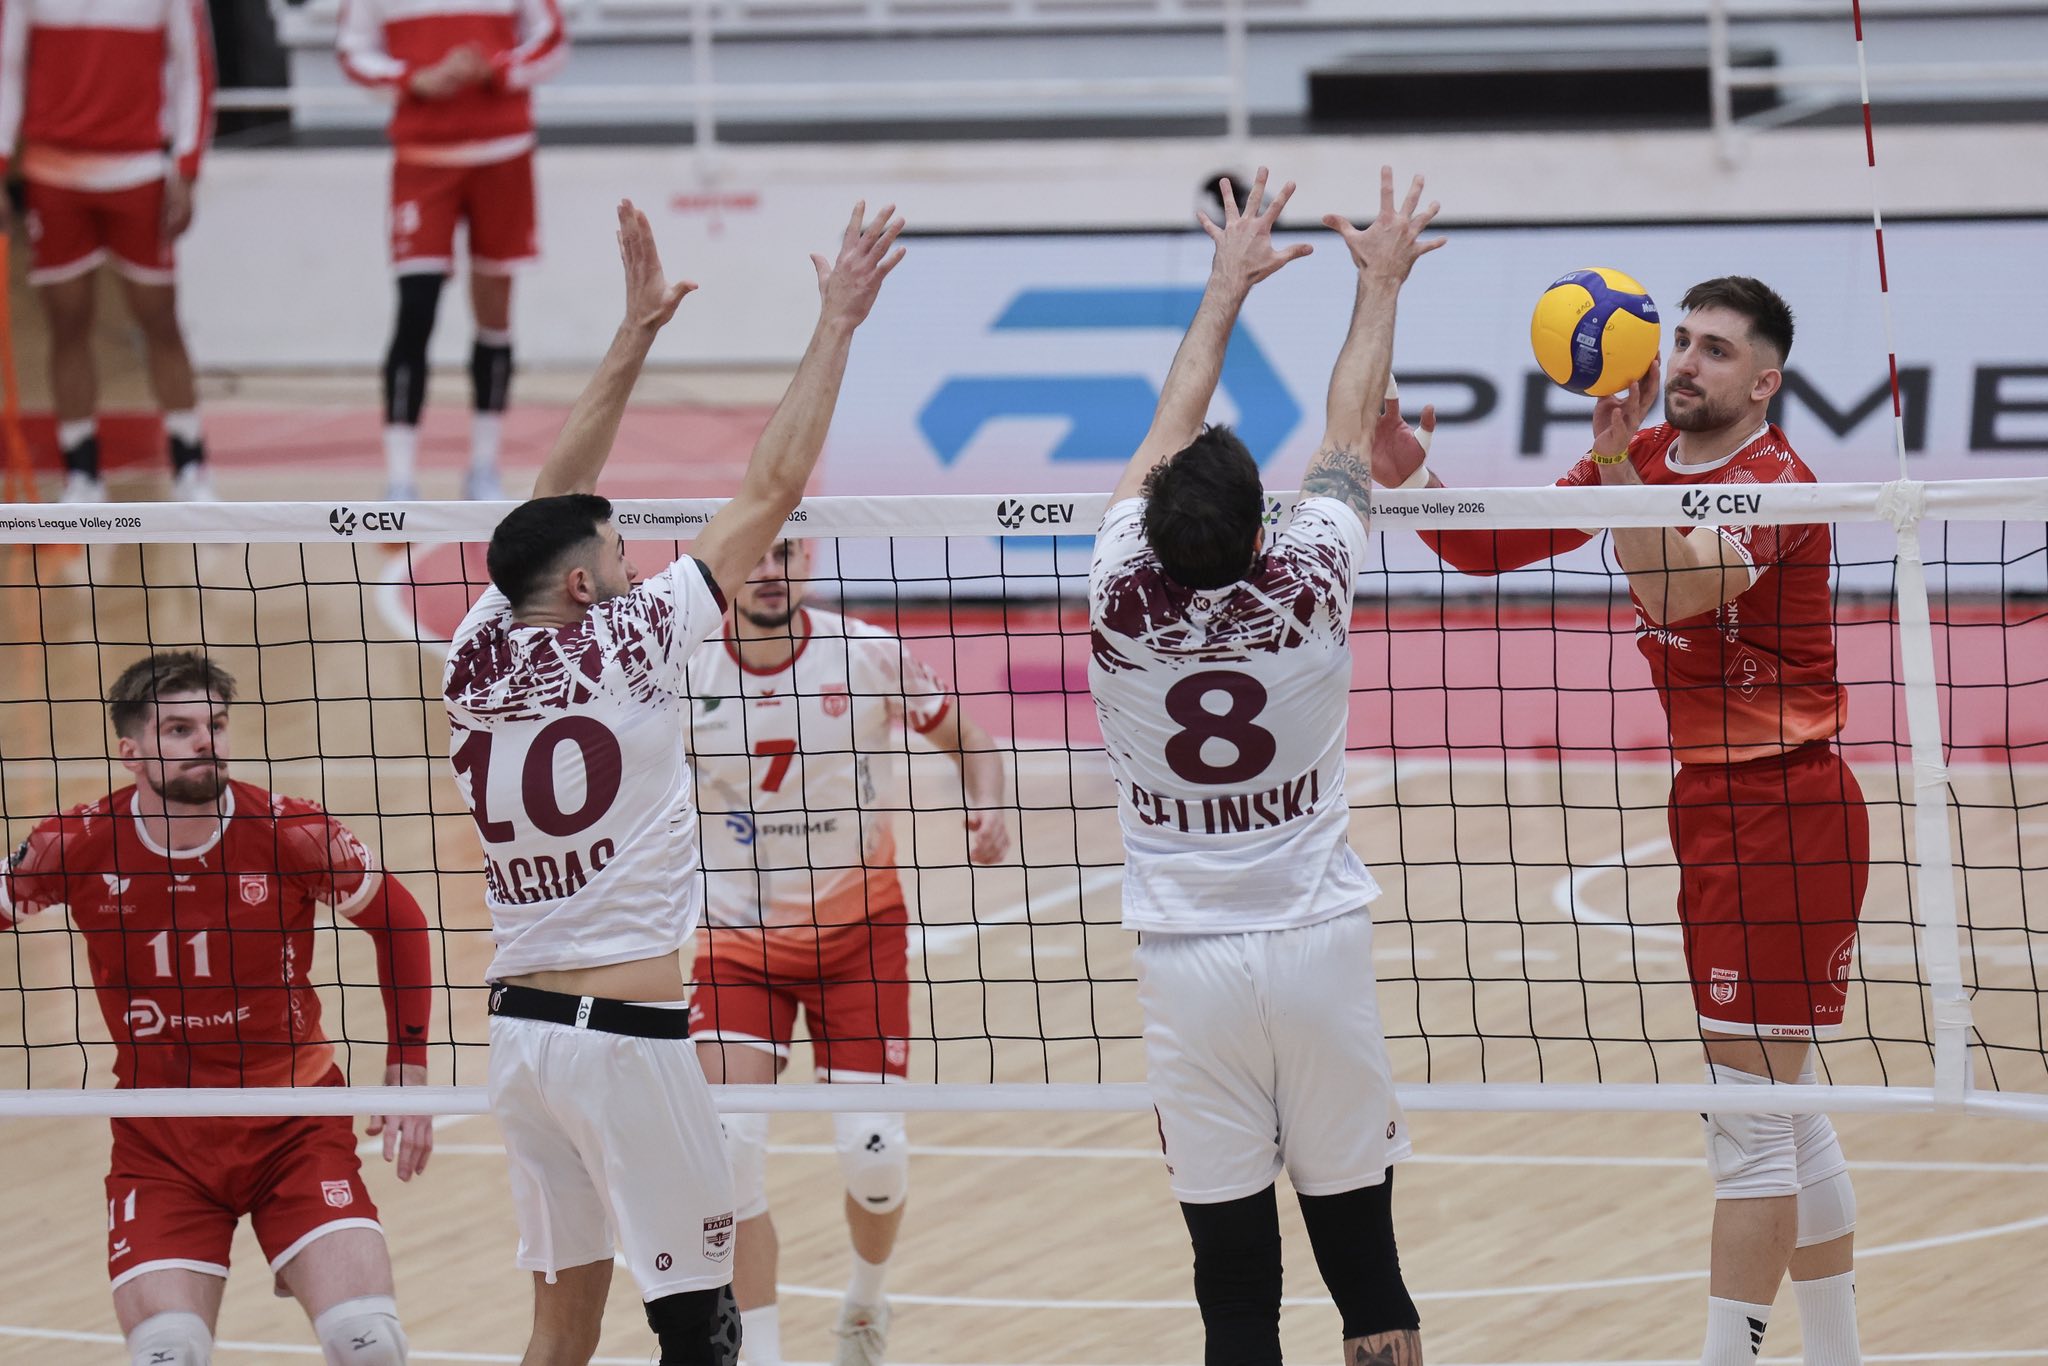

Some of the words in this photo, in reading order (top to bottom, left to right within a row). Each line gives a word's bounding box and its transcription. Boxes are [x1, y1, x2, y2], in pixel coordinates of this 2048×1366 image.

[1030, 503, 1074, 524] CEV
[1380, 504, 1418, 516] League
[1421, 502, 1455, 516] Volley
[1458, 502, 1485, 514] 2026
[1716, 494, 1762, 514] CEV
[38, 518, 78, 530] League
[80, 517, 112, 530] Volley
[115, 517, 142, 528] 2026
[362, 512, 406, 532] CEV
[619, 514, 640, 525] CEV
[643, 512, 703, 526] Champions
[785, 511, 807, 522] 026
[1741, 659, 1757, 694] OVD
[1165, 670, 1276, 784] 8
[754, 739, 796, 792] 7
[451, 716, 622, 843] 10
[762, 818, 838, 836] PRIME
[146, 931, 211, 977] 11
[170, 1006, 250, 1028] PRIME
[1771, 1028, 1780, 1036] CS
[1781, 1028, 1810, 1036] DINAMO
[707, 1219, 731, 1230] RAPID
